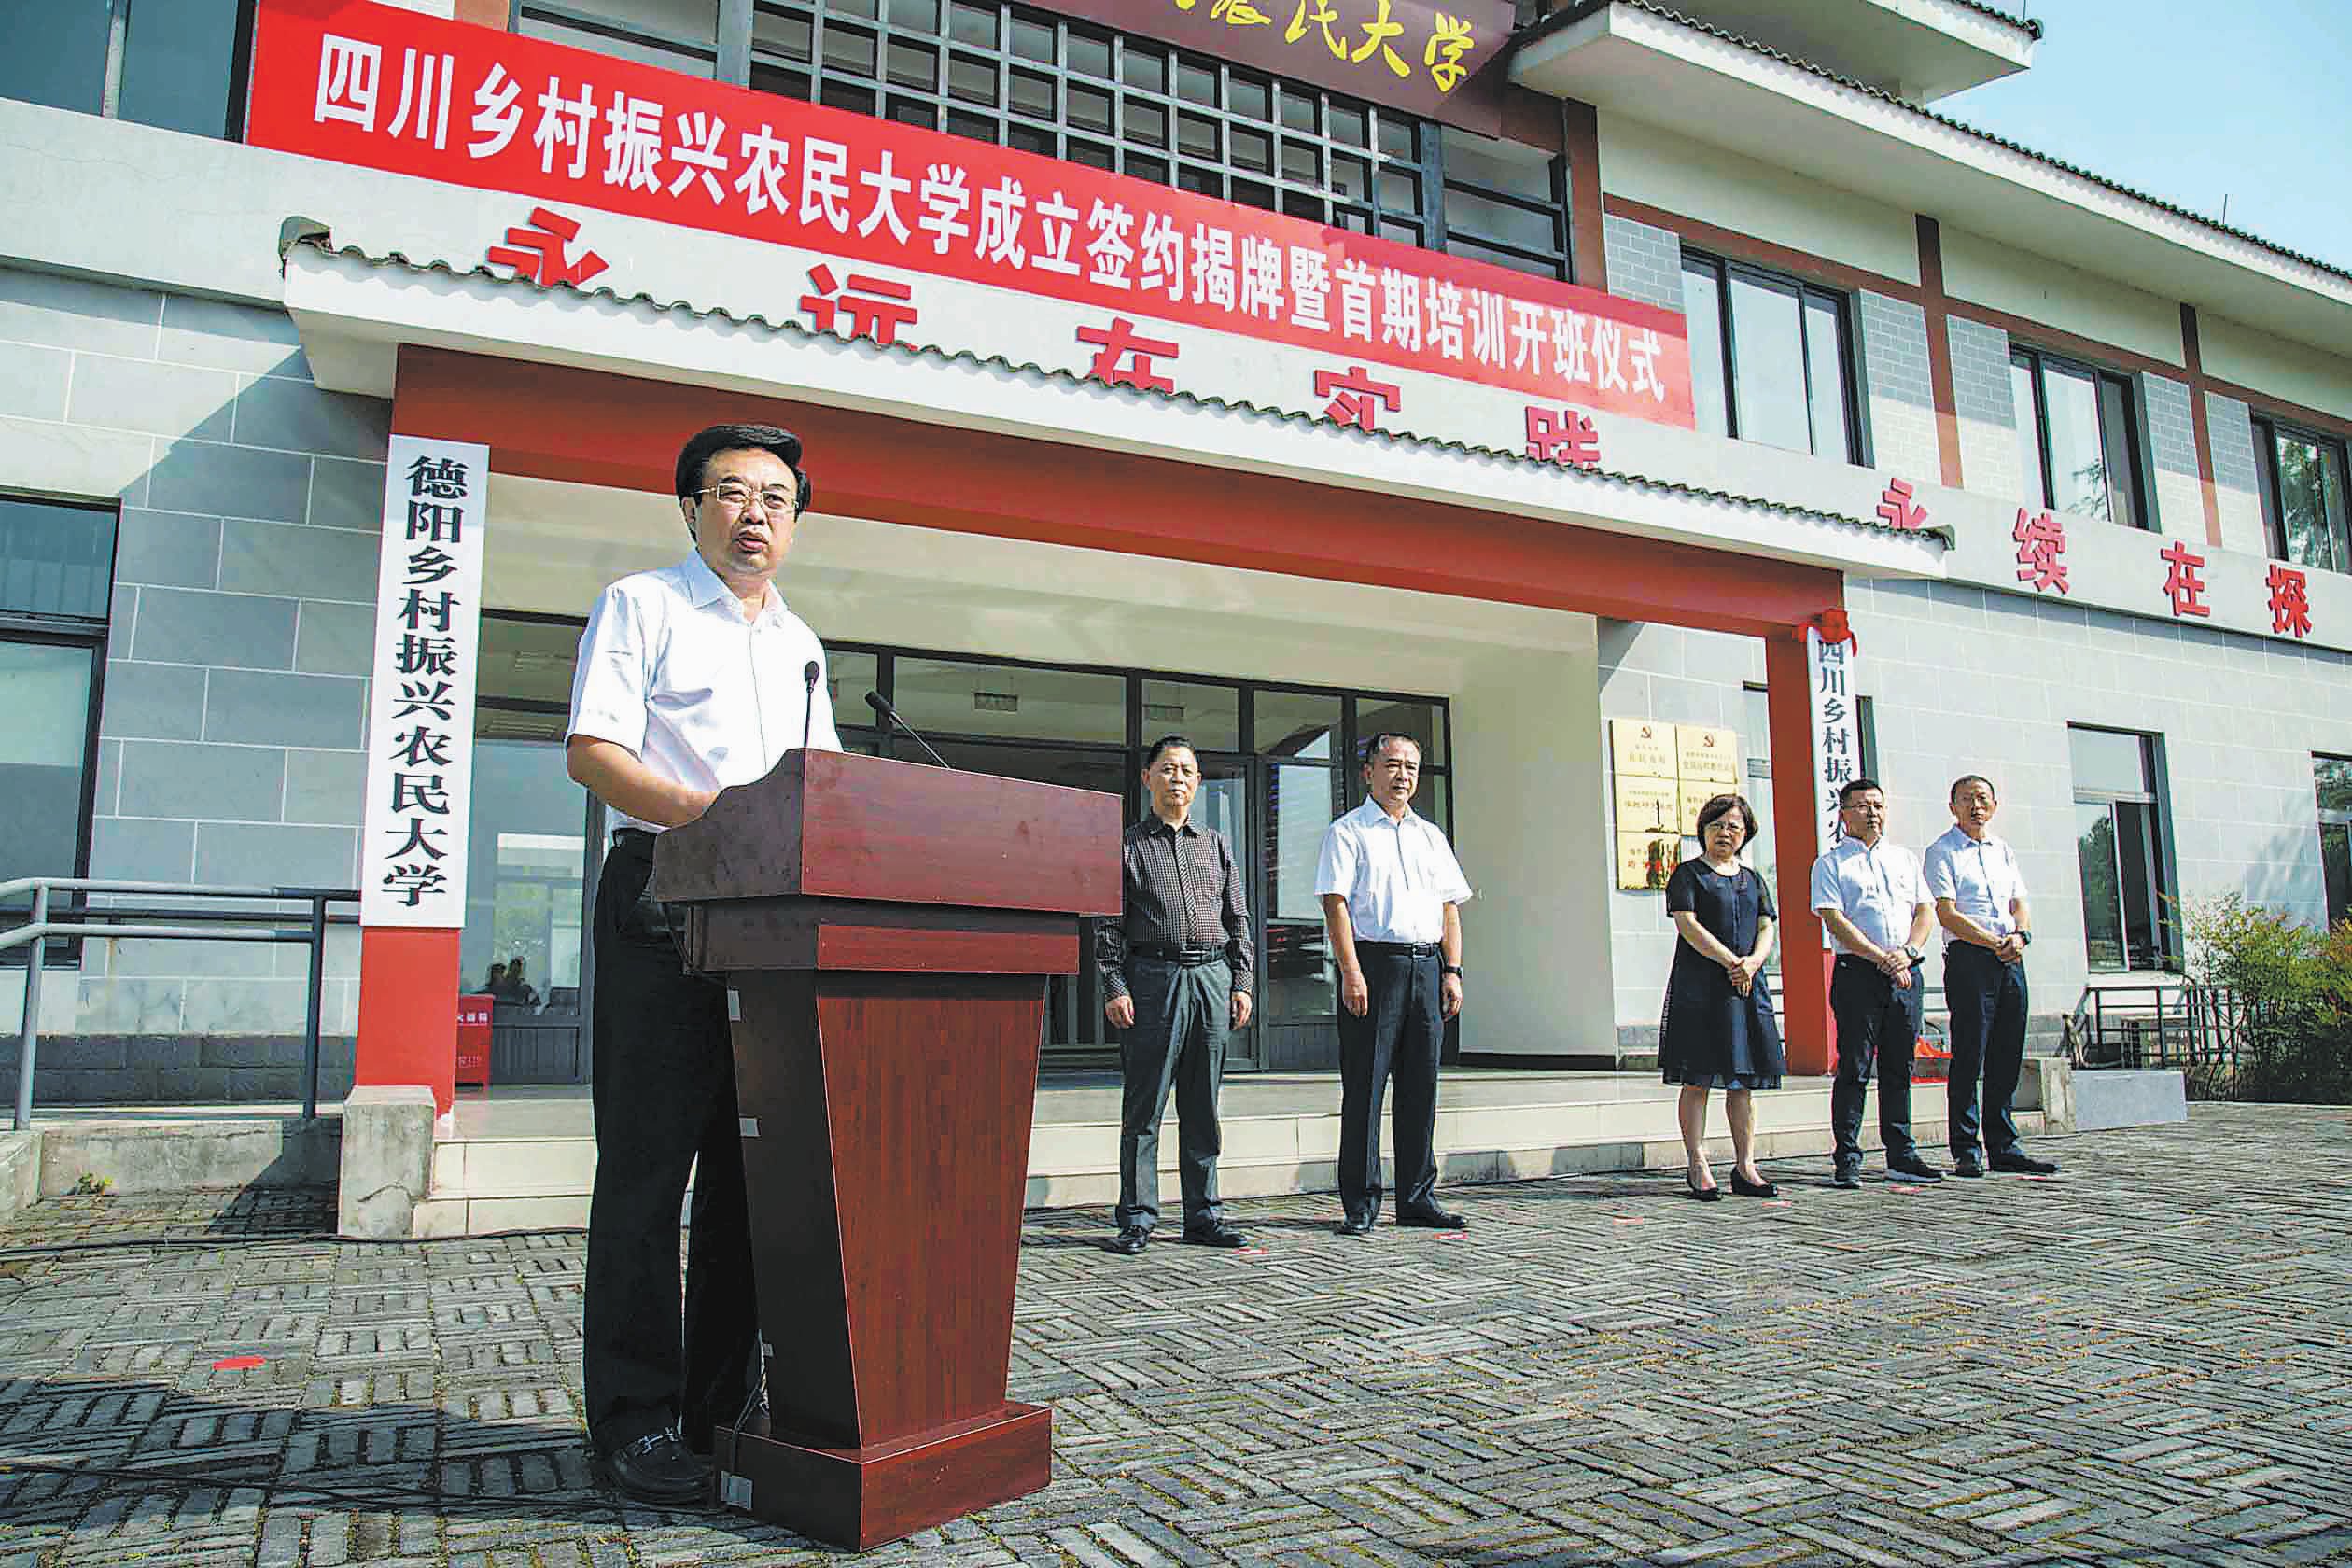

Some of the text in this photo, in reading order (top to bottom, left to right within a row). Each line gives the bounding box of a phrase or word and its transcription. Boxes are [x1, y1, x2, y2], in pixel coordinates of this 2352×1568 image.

[314, 34, 1665, 402] 四川乡村振兴农民大学成立签约揭牌暨首期培训开班仪式
[1174, 0, 1477, 92] 民大学
[381, 455, 469, 909] 德阳乡村振兴农民大学
